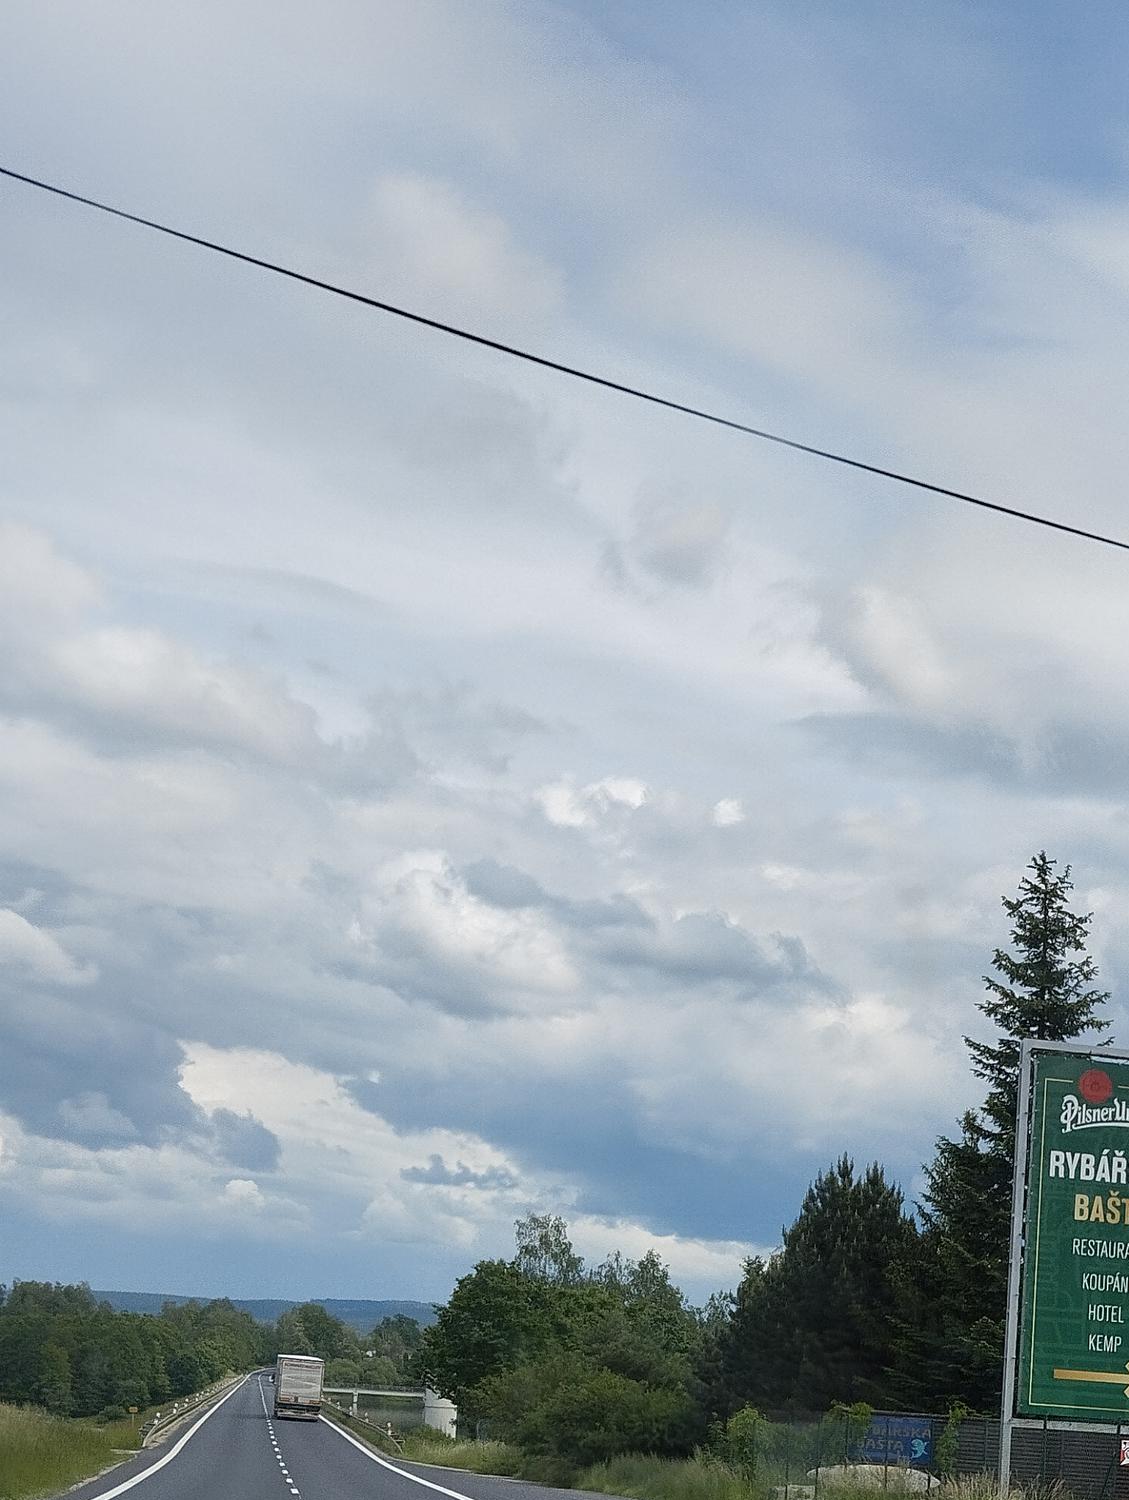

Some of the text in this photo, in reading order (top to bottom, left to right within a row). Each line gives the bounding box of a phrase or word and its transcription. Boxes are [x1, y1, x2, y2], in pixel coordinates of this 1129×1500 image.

[1061, 1095, 1115, 1133] Pilsner
[1088, 1304, 1124, 1323] HOTEL
[1088, 1334, 1122, 1353] KEMP
